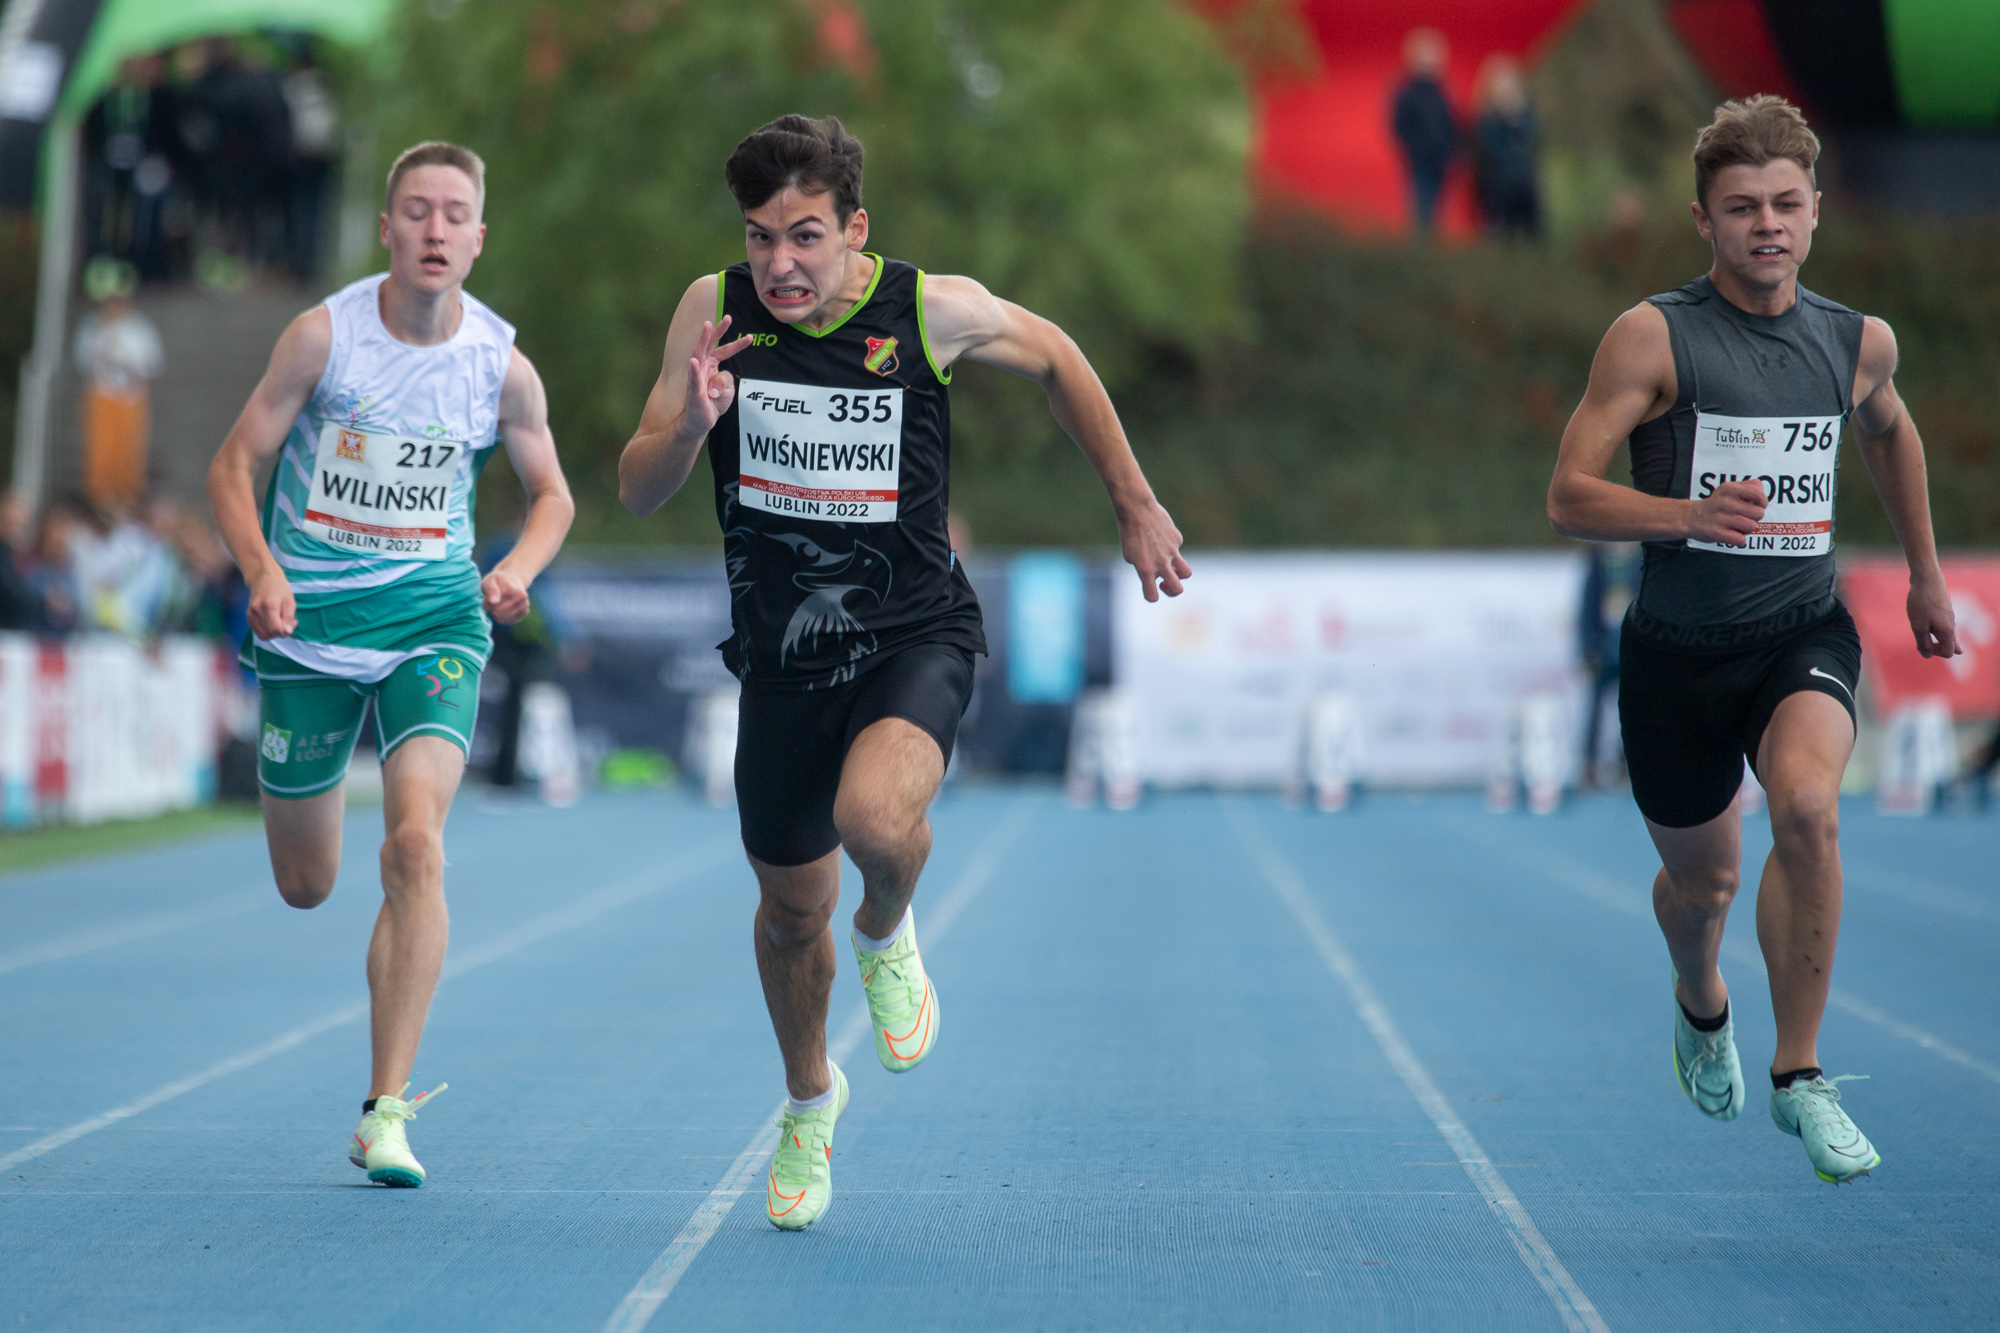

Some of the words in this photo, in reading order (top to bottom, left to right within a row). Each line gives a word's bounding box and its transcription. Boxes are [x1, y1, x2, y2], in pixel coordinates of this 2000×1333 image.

[827, 394, 892, 423] 355
[1702, 426, 1750, 443] lublin
[1783, 421, 1833, 452] 756
[396, 442, 455, 468] 217
[746, 432, 894, 472] WIŚNIEWSKI
[321, 469, 447, 511] WILIŃSKI
[765, 493, 820, 515] LUBLIN
[826, 503, 869, 517] 2022
[328, 528, 380, 549] LUBLIN
[385, 539, 422, 552] 2022
[1780, 535, 1816, 550] 2022
